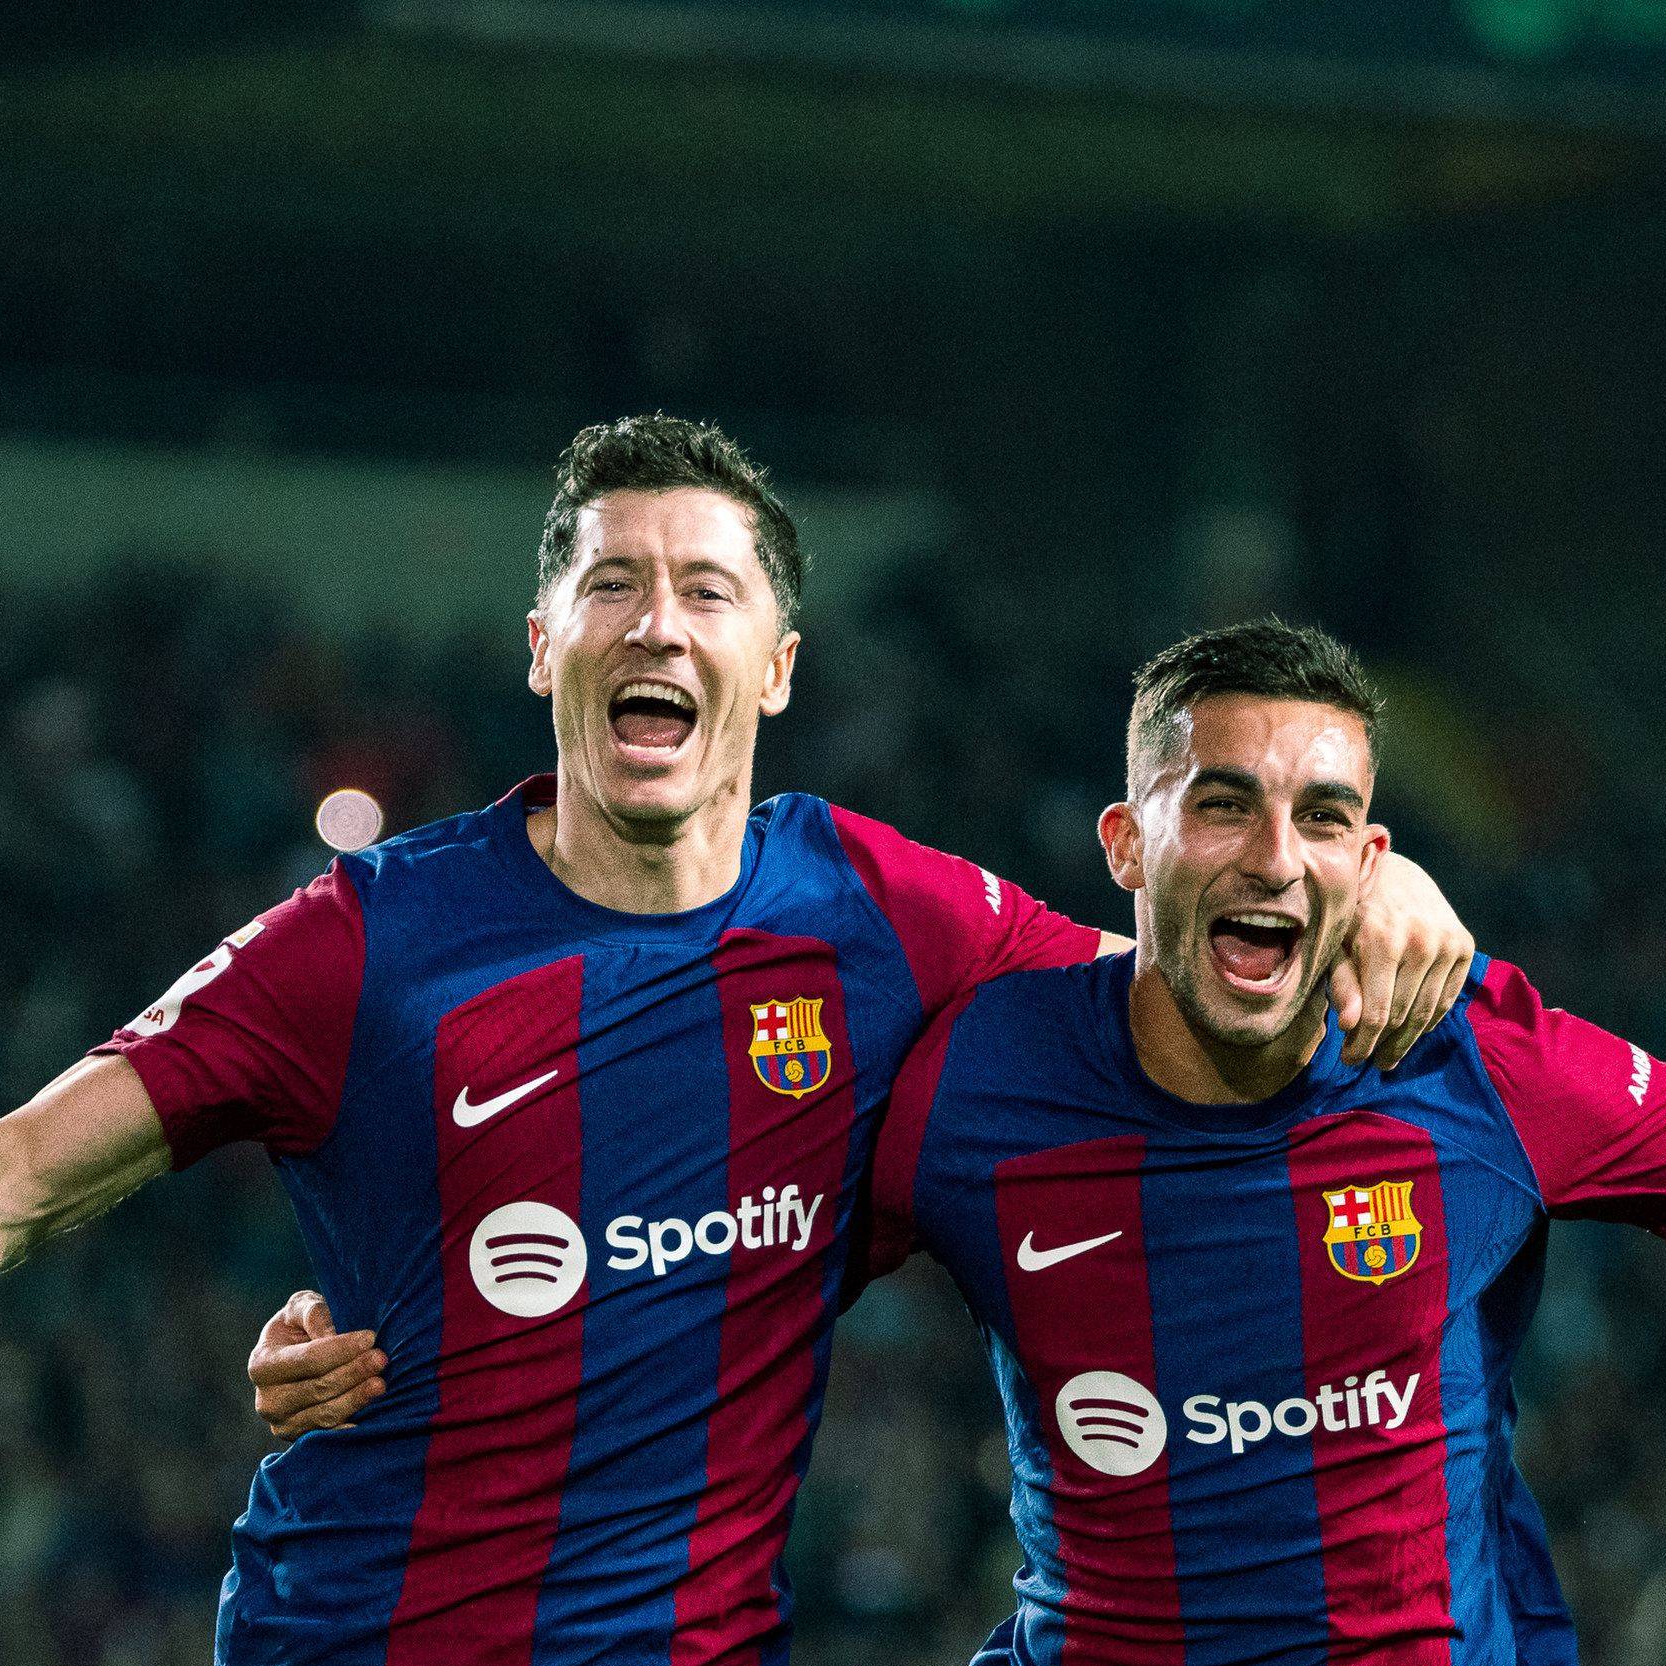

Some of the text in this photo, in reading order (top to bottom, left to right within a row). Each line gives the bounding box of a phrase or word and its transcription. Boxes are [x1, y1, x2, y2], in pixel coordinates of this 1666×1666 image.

[774, 1040, 806, 1053] FCB
[605, 1183, 825, 1276] Spotify
[1354, 1224, 1391, 1238] FCB
[1185, 1368, 1421, 1454] Spotify
